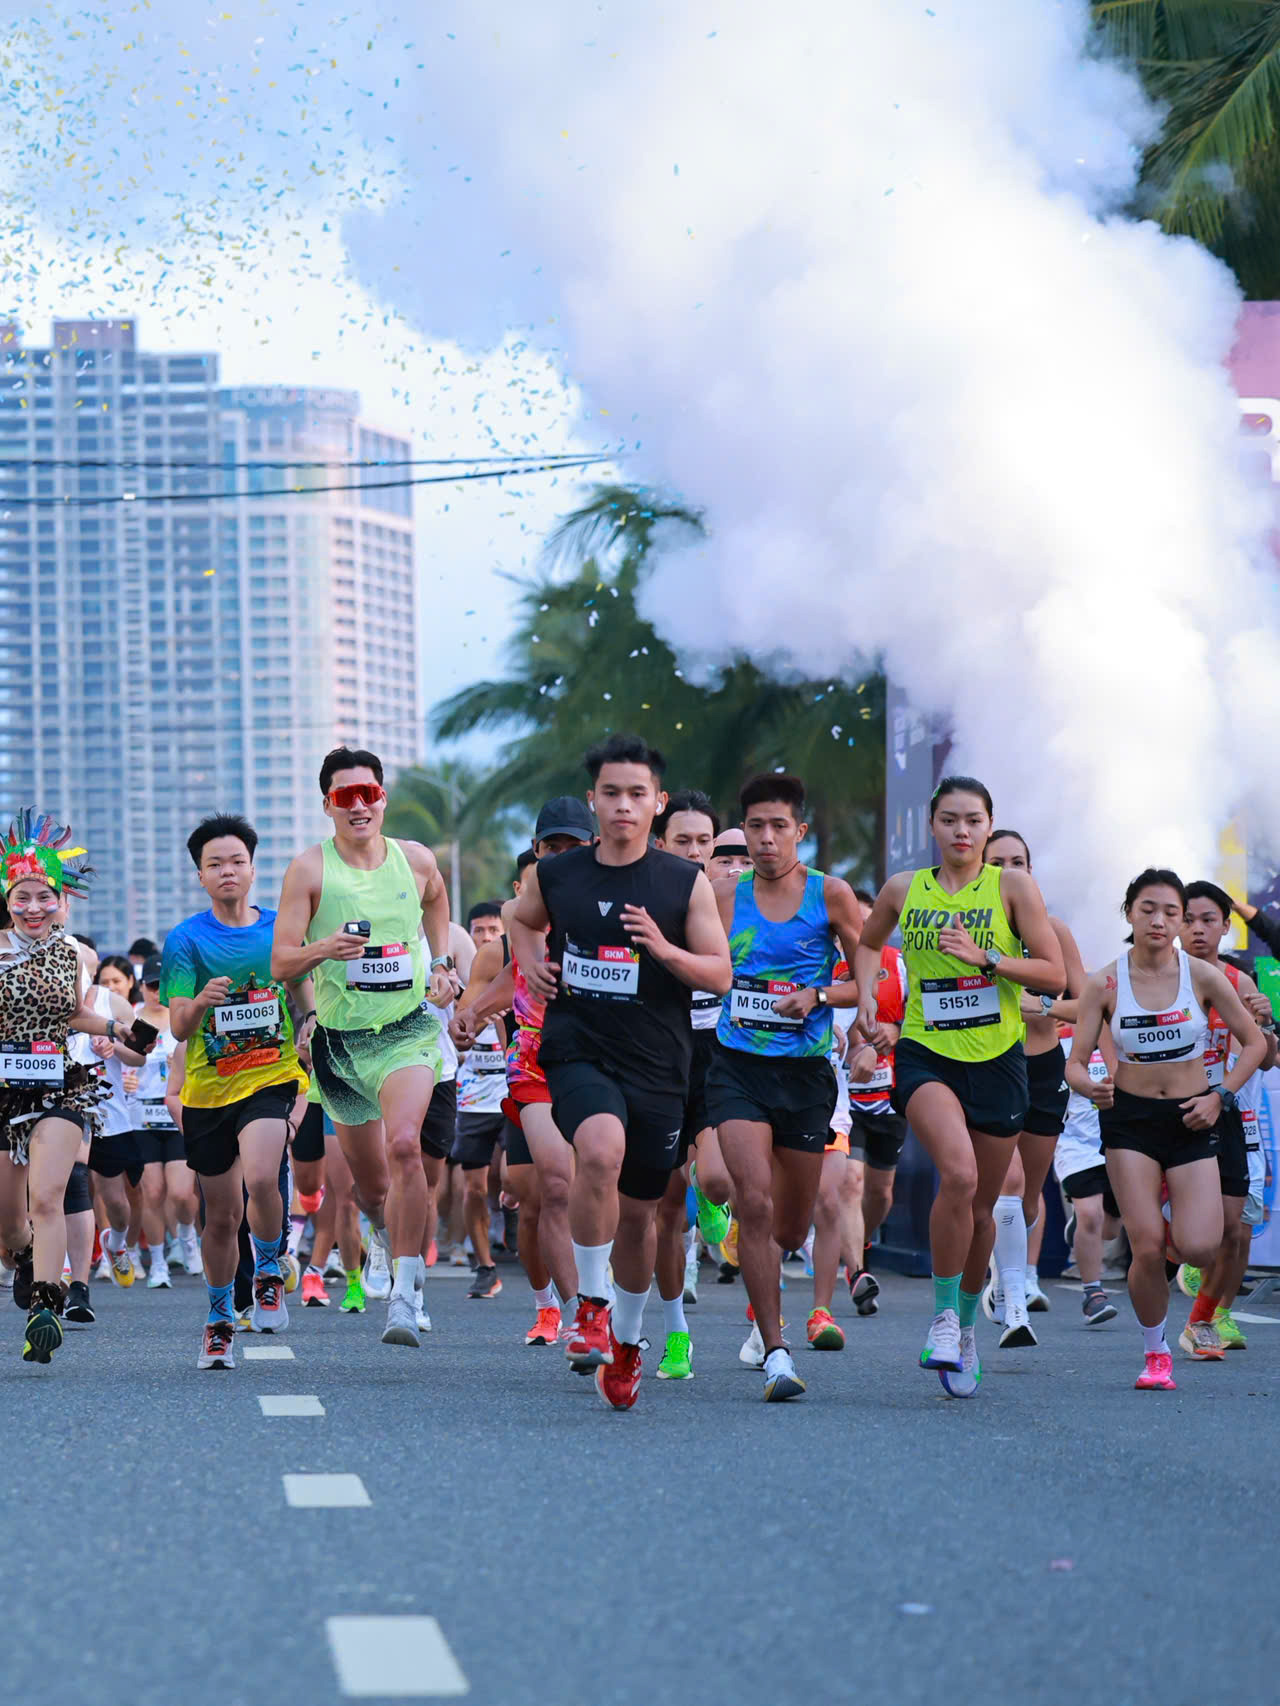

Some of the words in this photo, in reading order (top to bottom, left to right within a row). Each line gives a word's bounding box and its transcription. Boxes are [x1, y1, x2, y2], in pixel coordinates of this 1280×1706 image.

[362, 961, 400, 974] 51308
[567, 960, 578, 976] M
[580, 965, 631, 982] 50057
[737, 996, 749, 1009] M
[939, 995, 979, 1010] 51512
[221, 1011, 233, 1022] M
[236, 1005, 274, 1021] 50063
[1138, 1028, 1182, 1044] 50001
[4, 1058, 12, 1069] F
[15, 1059, 56, 1070] 50096
